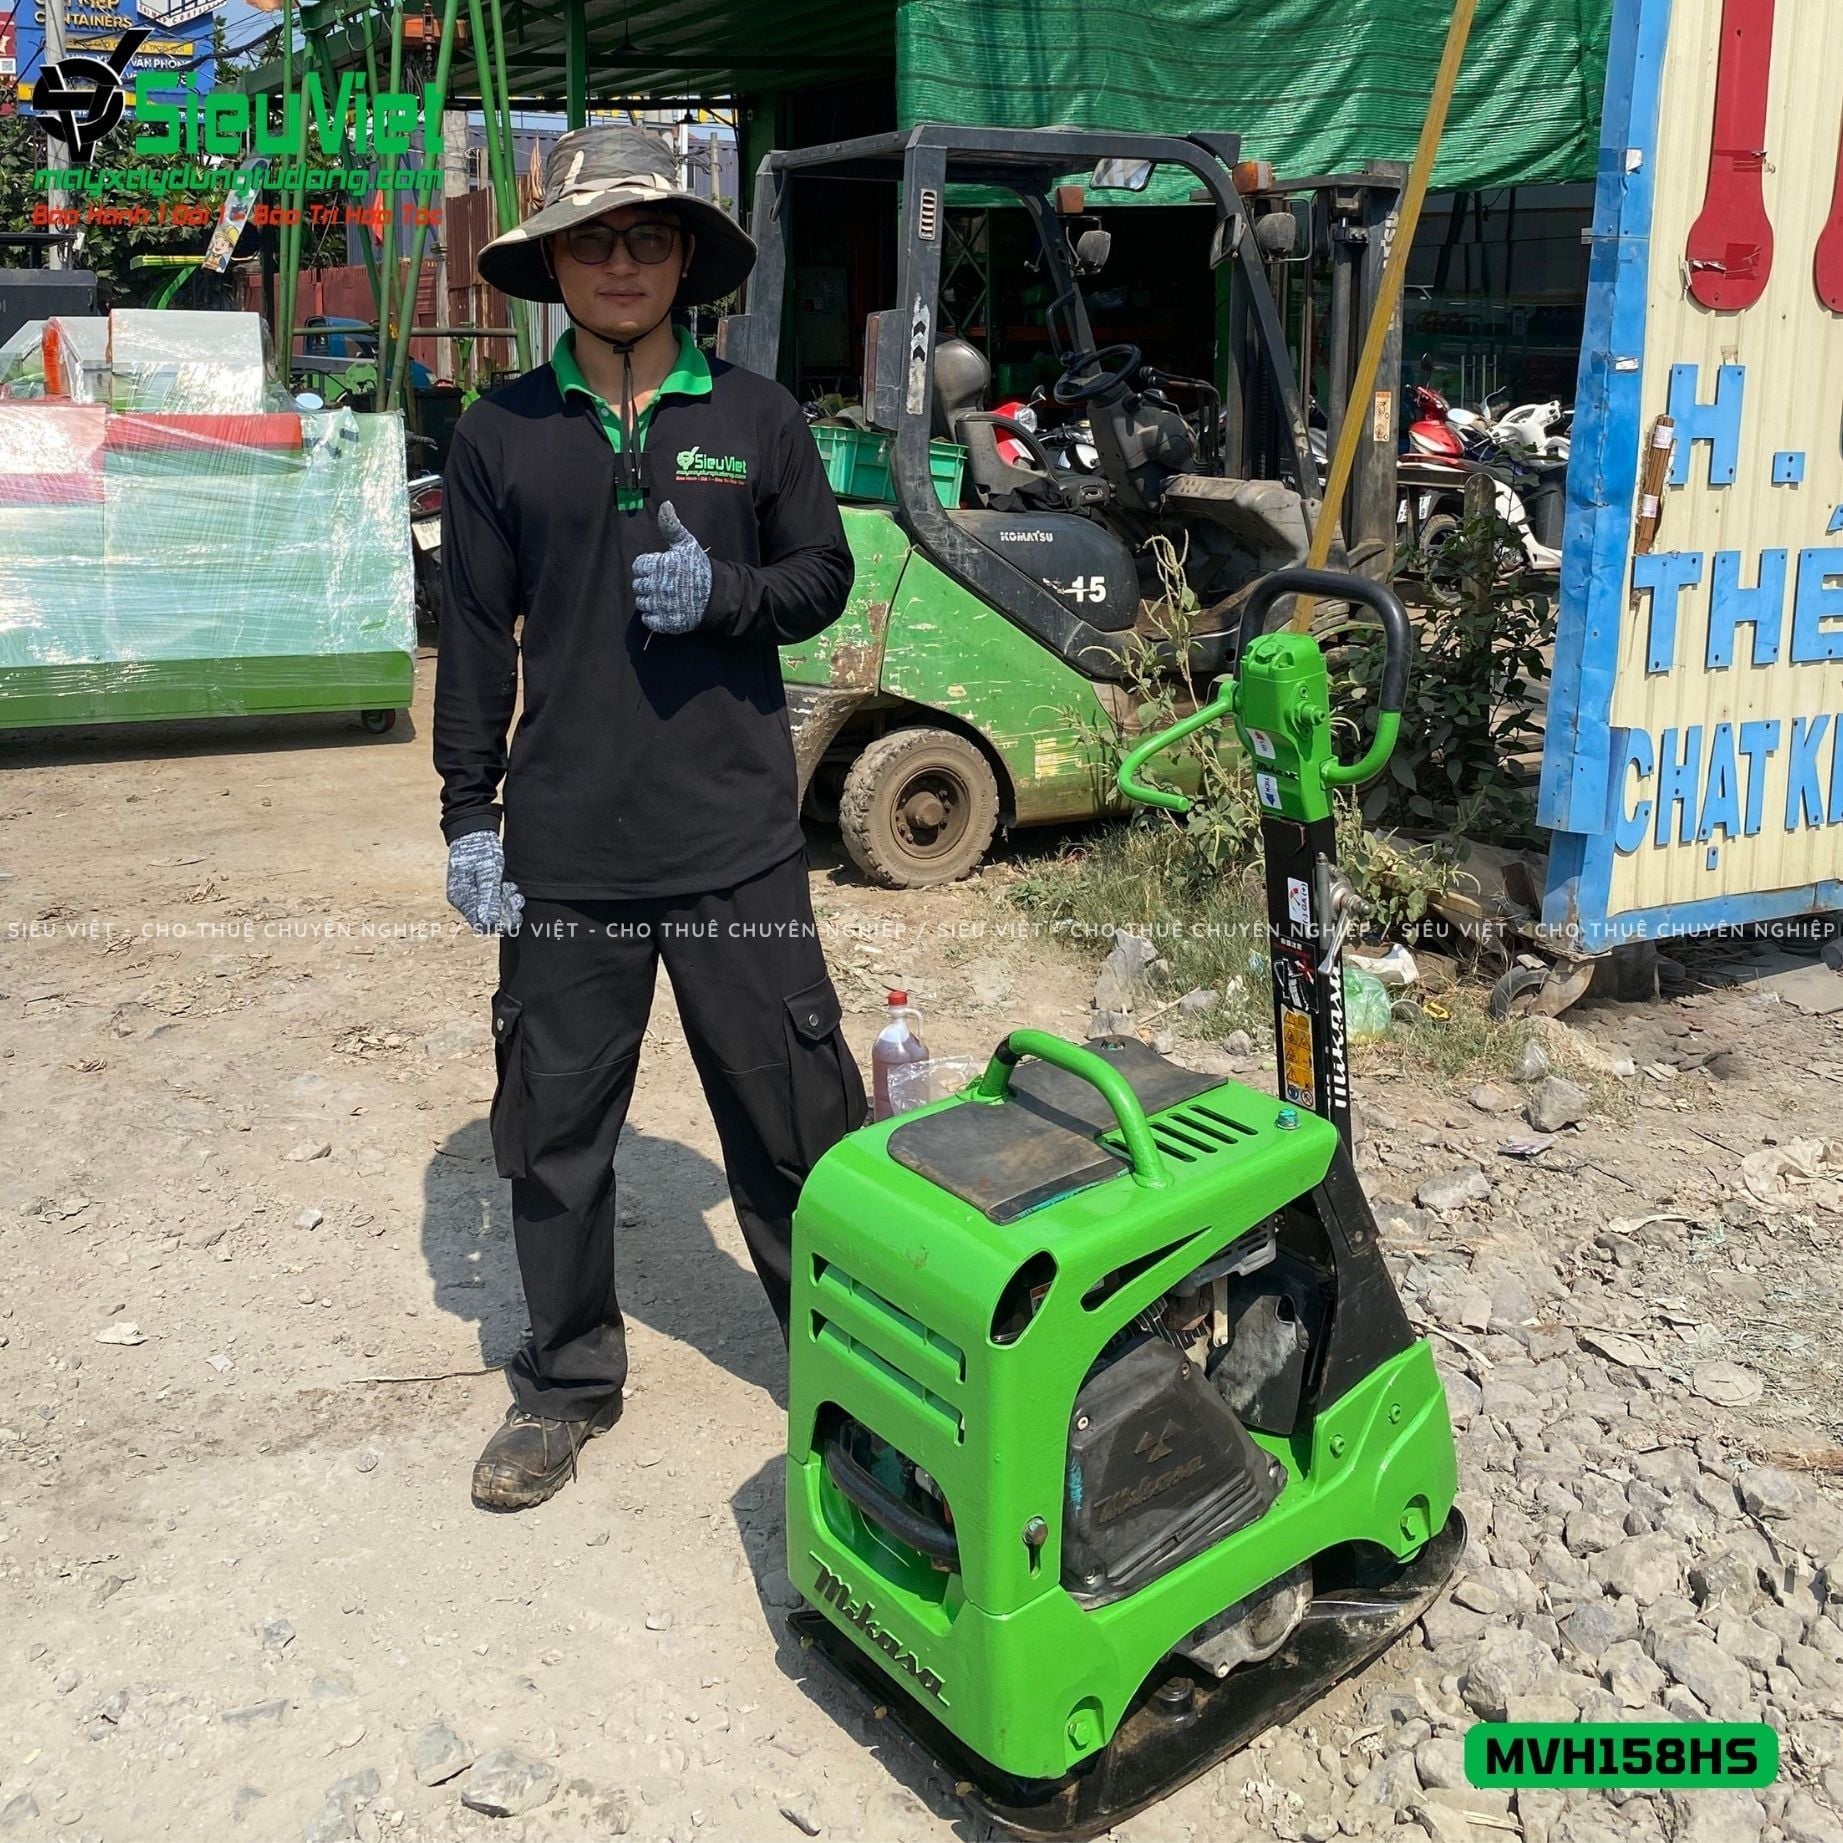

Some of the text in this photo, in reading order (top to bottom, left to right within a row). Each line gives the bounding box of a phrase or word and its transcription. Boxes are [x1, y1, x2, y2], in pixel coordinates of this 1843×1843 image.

[34, 10, 133, 29] CNTAINERS
[1000, 530, 1054, 542] KOMATSU
[1785, 713, 1843, 832] K
